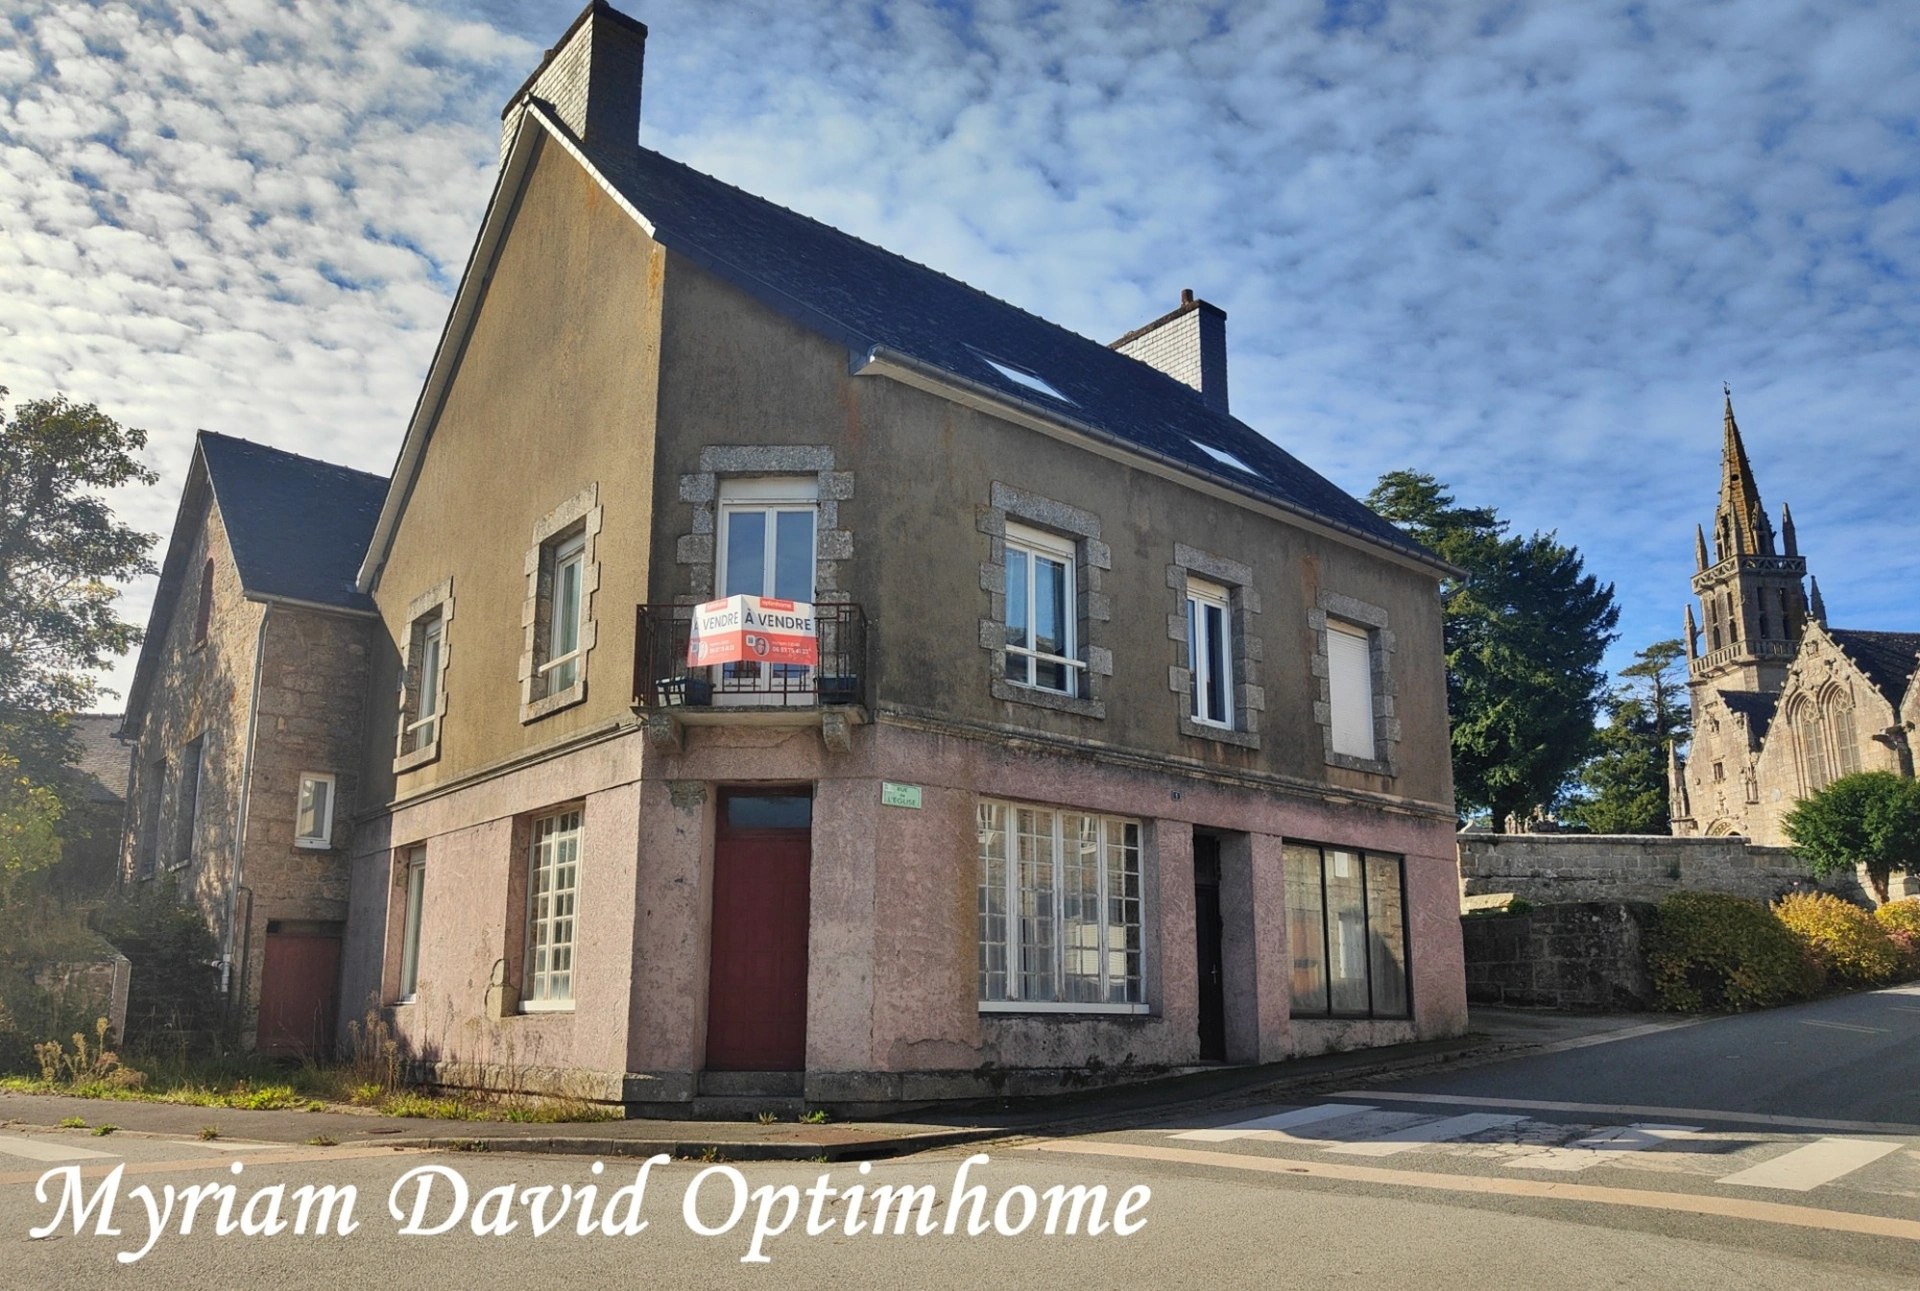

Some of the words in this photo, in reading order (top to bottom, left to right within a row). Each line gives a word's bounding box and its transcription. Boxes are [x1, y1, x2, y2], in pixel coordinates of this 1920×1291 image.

[703, 611, 739, 631] VENDRE
[744, 608, 755, 625] À
[758, 613, 811, 631] VENDRE
